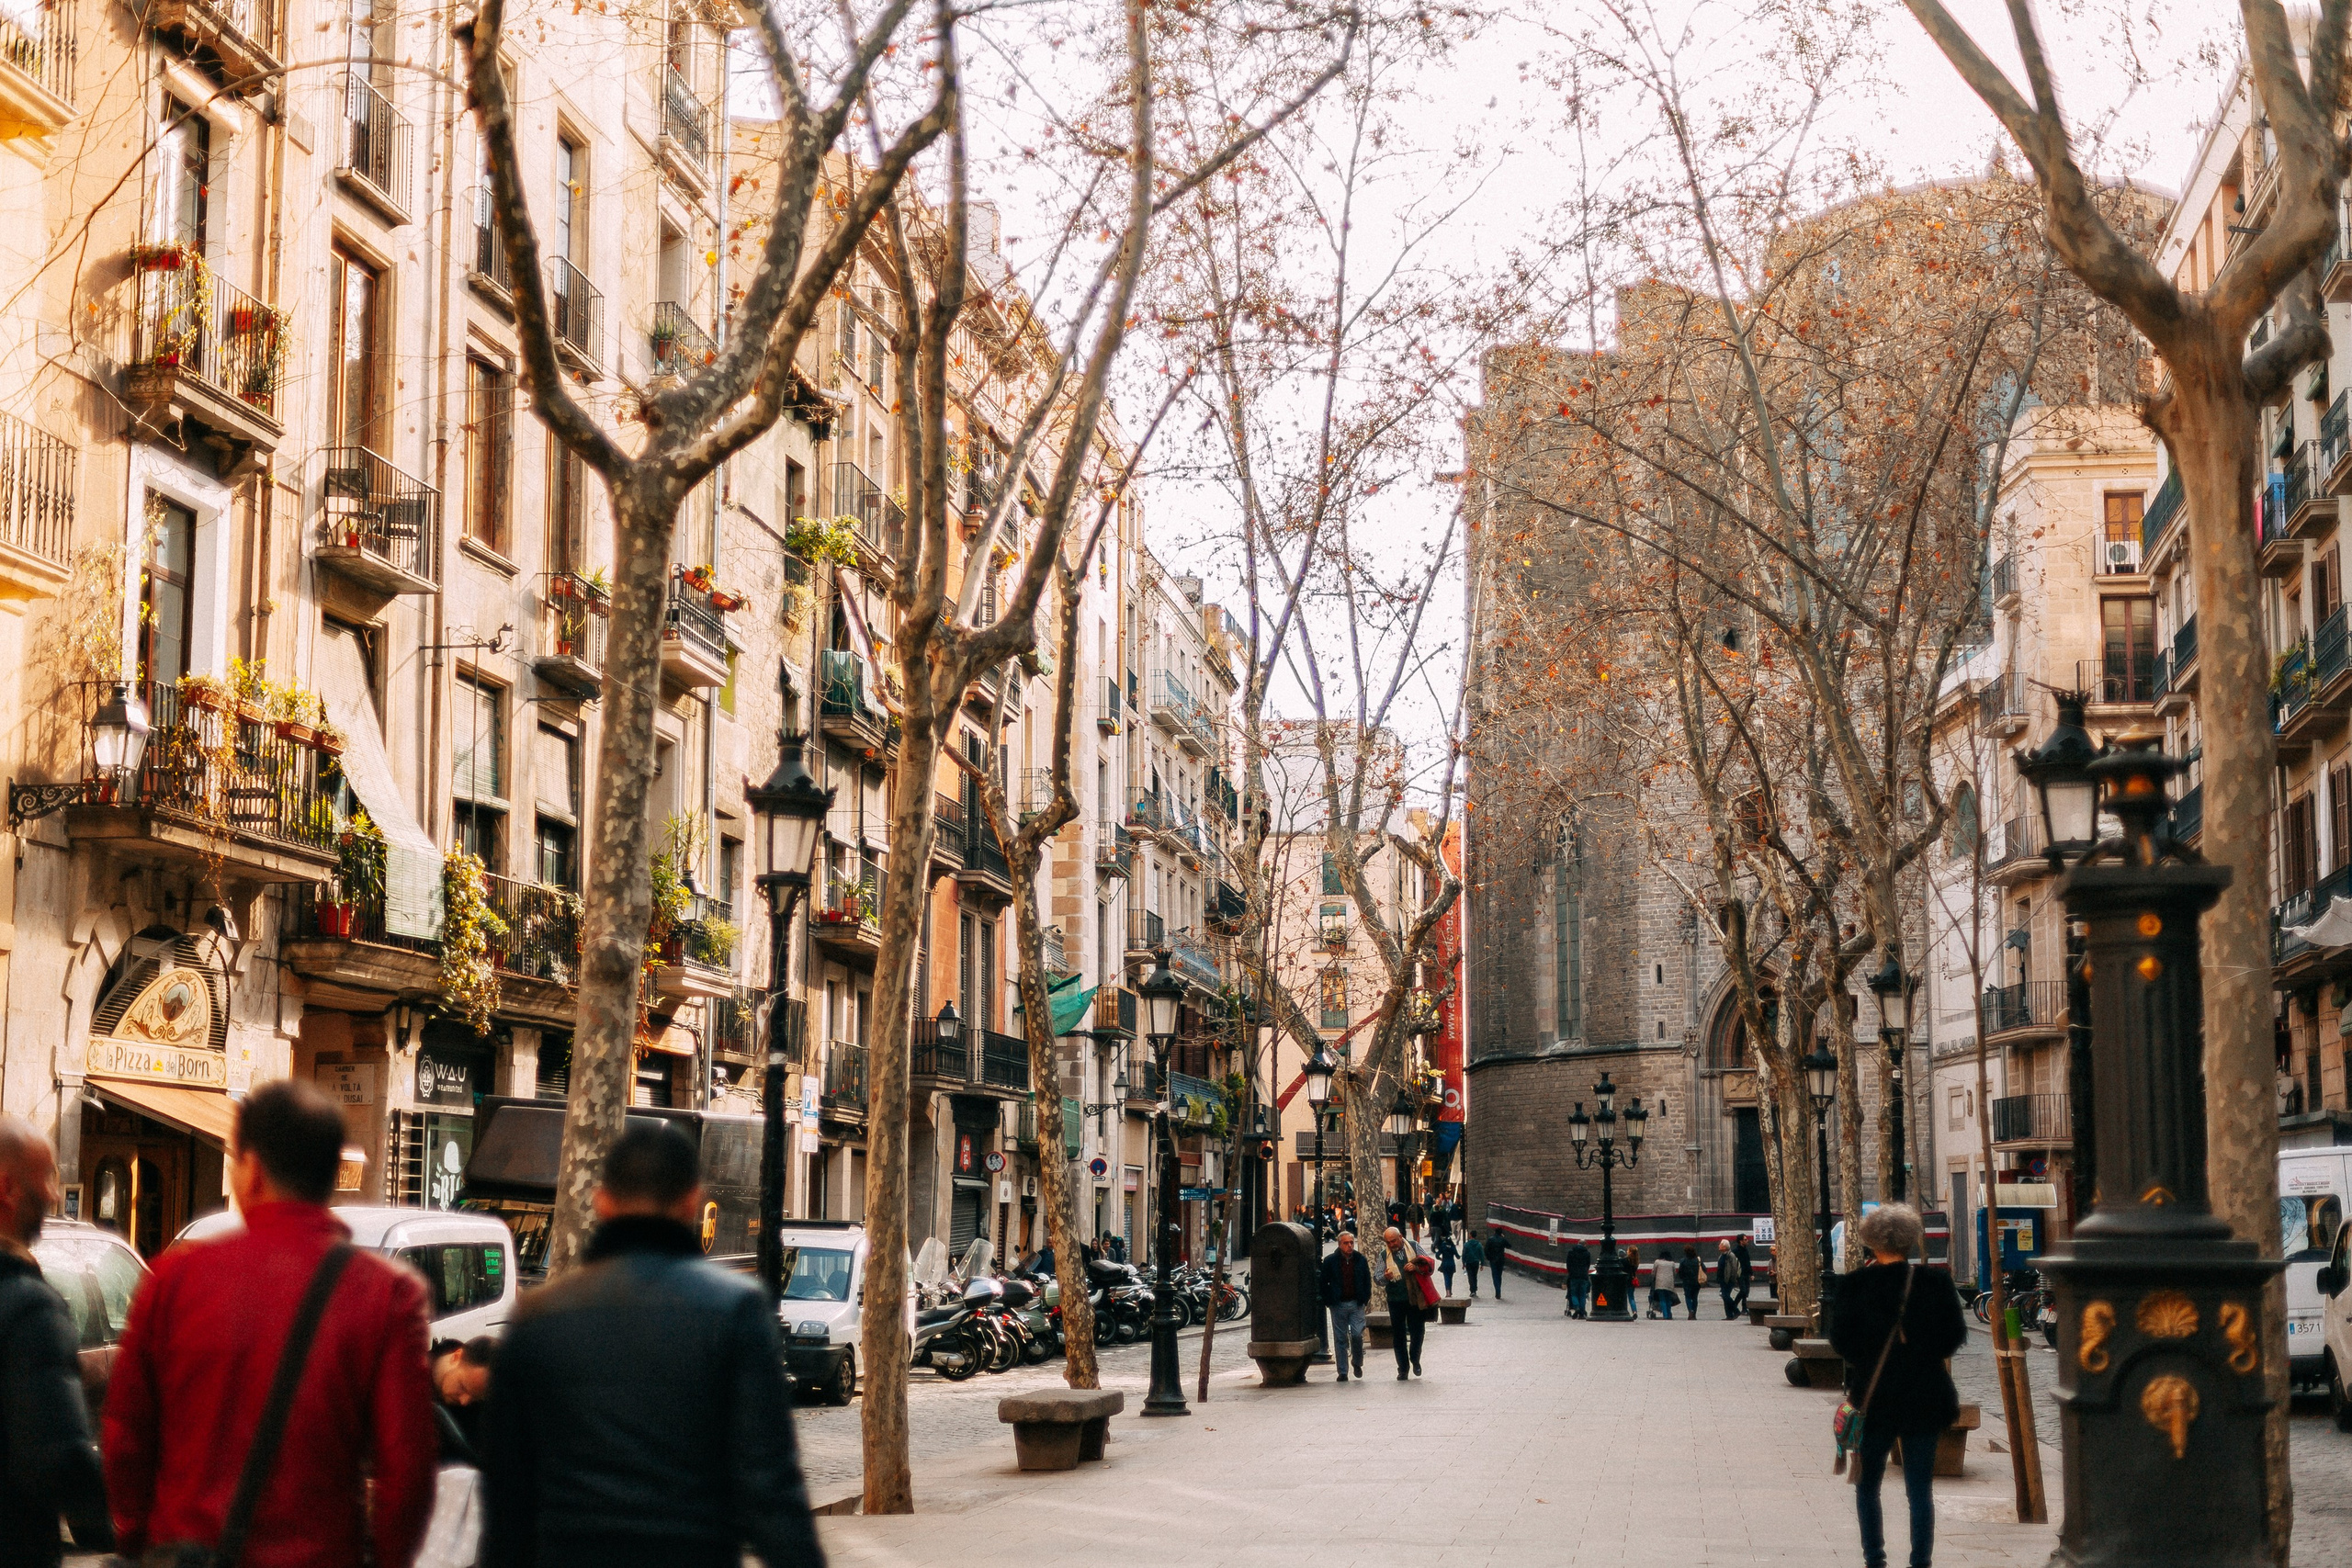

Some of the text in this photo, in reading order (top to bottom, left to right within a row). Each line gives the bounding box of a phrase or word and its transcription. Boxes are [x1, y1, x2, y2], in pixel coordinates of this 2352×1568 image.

[106, 1046, 210, 1078] la Pizza del Born
[340, 1083, 361, 1091] VOLTA
[344, 1094, 363, 1103] DUSAI
[703, 1218, 716, 1246] ups
[2297, 1323, 2321, 1333] 3571
